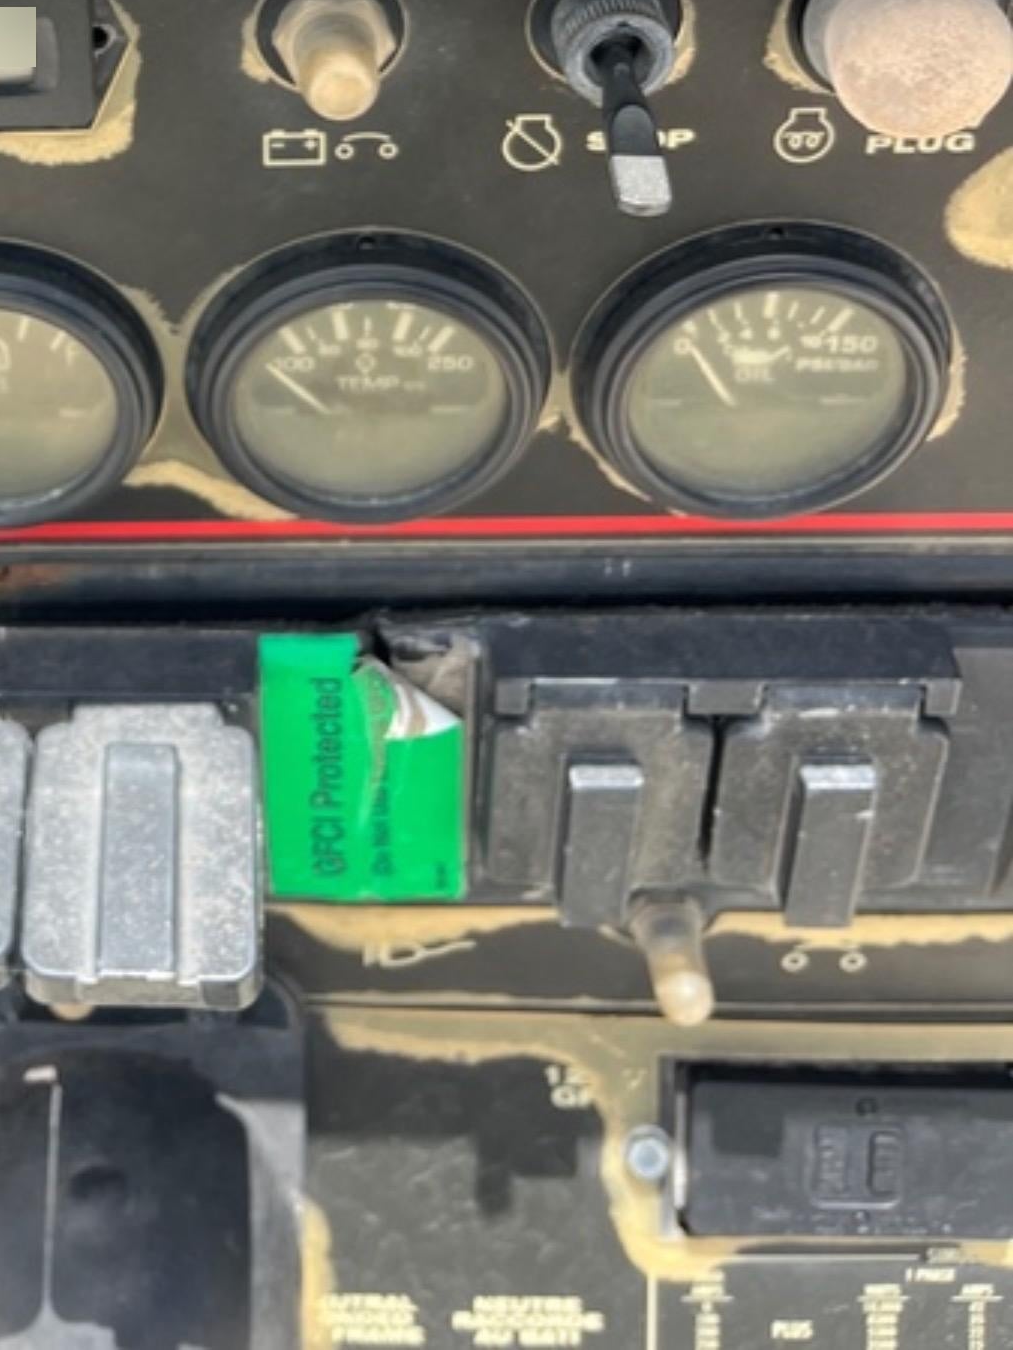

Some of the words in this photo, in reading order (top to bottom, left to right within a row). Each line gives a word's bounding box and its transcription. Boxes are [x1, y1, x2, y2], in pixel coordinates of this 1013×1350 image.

[586, 128, 696, 151] SP
[865, 131, 975, 155] PLUG
[308, 677, 344, 810] Protected
